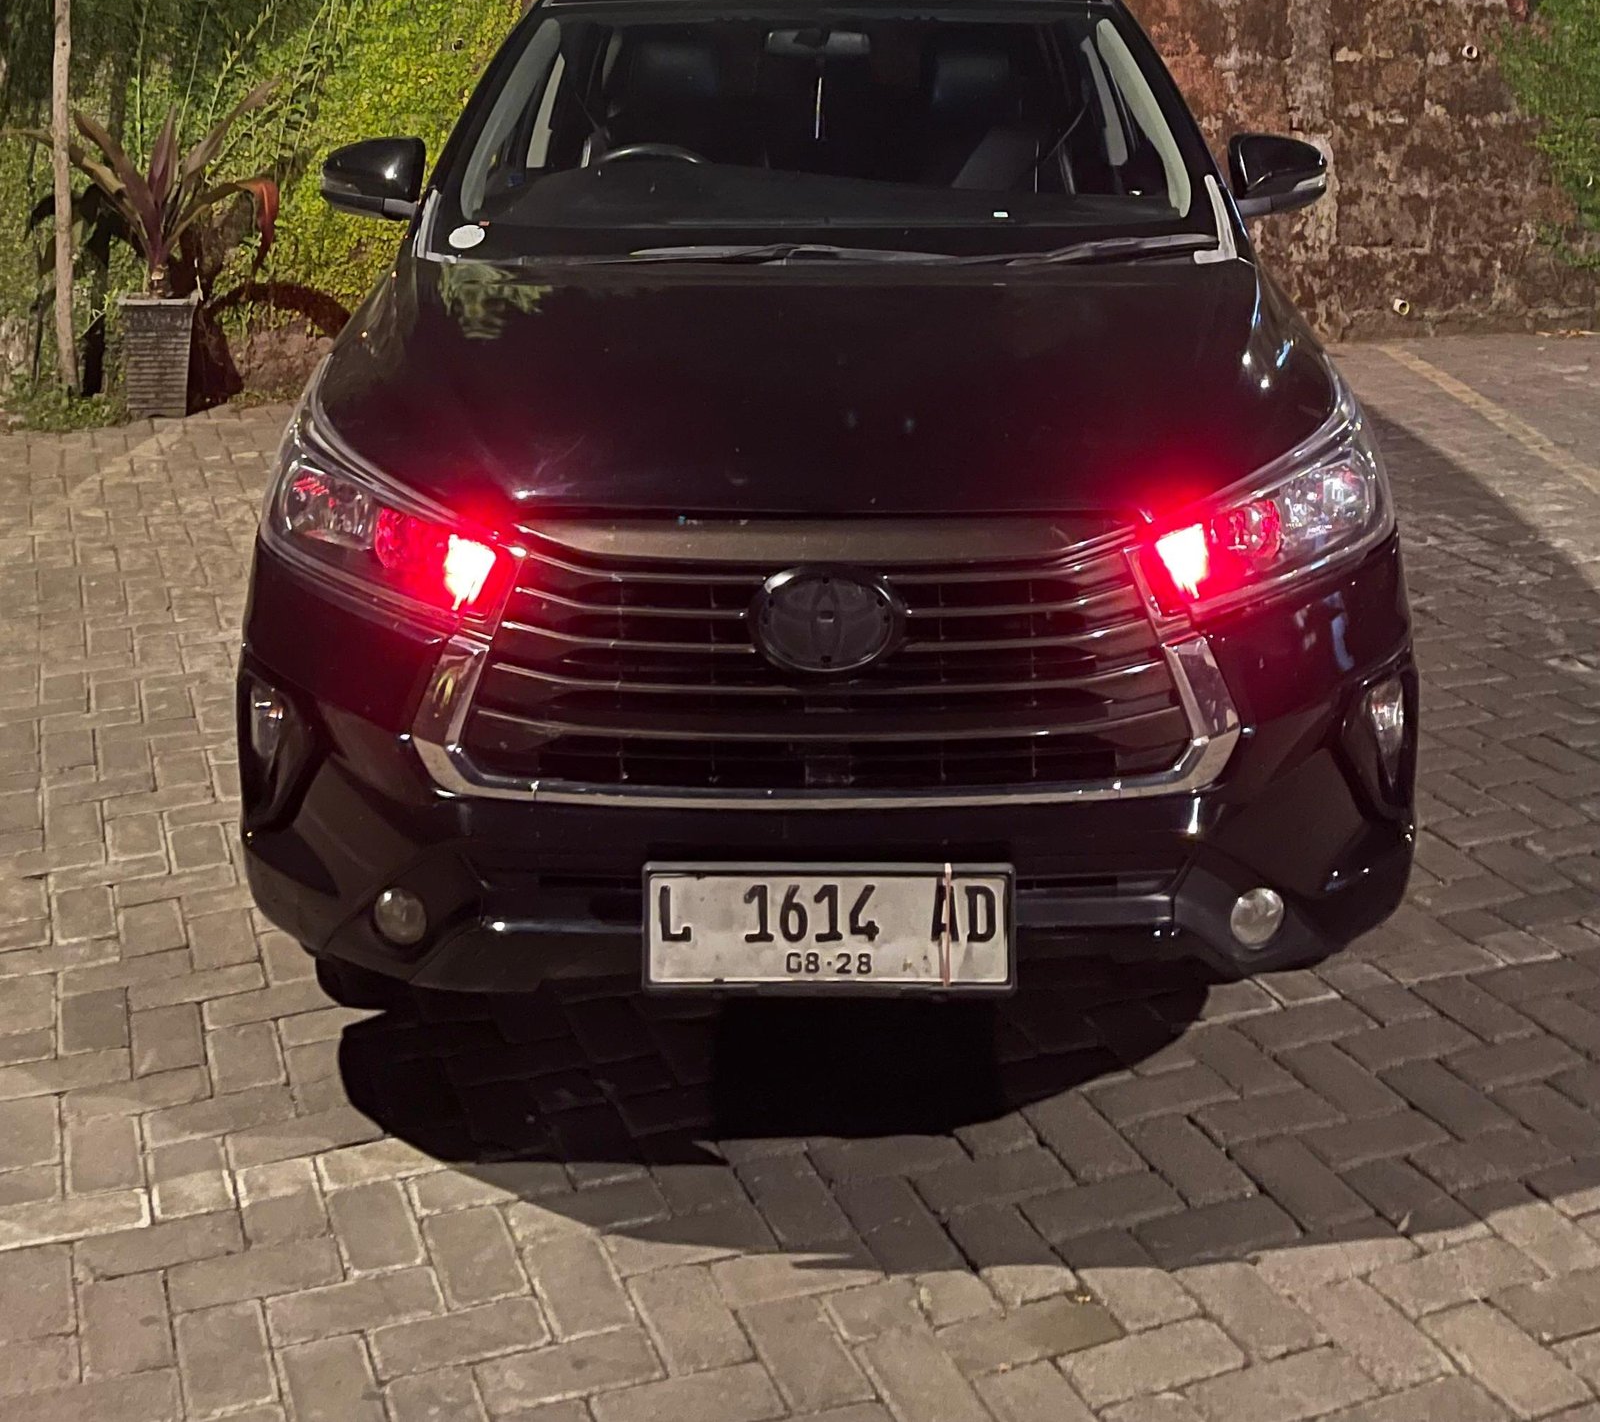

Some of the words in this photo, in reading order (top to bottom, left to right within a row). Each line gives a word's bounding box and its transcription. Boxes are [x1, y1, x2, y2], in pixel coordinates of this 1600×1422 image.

[658, 884, 692, 943] L
[743, 884, 880, 943] 1614
[930, 883, 997, 943] AD
